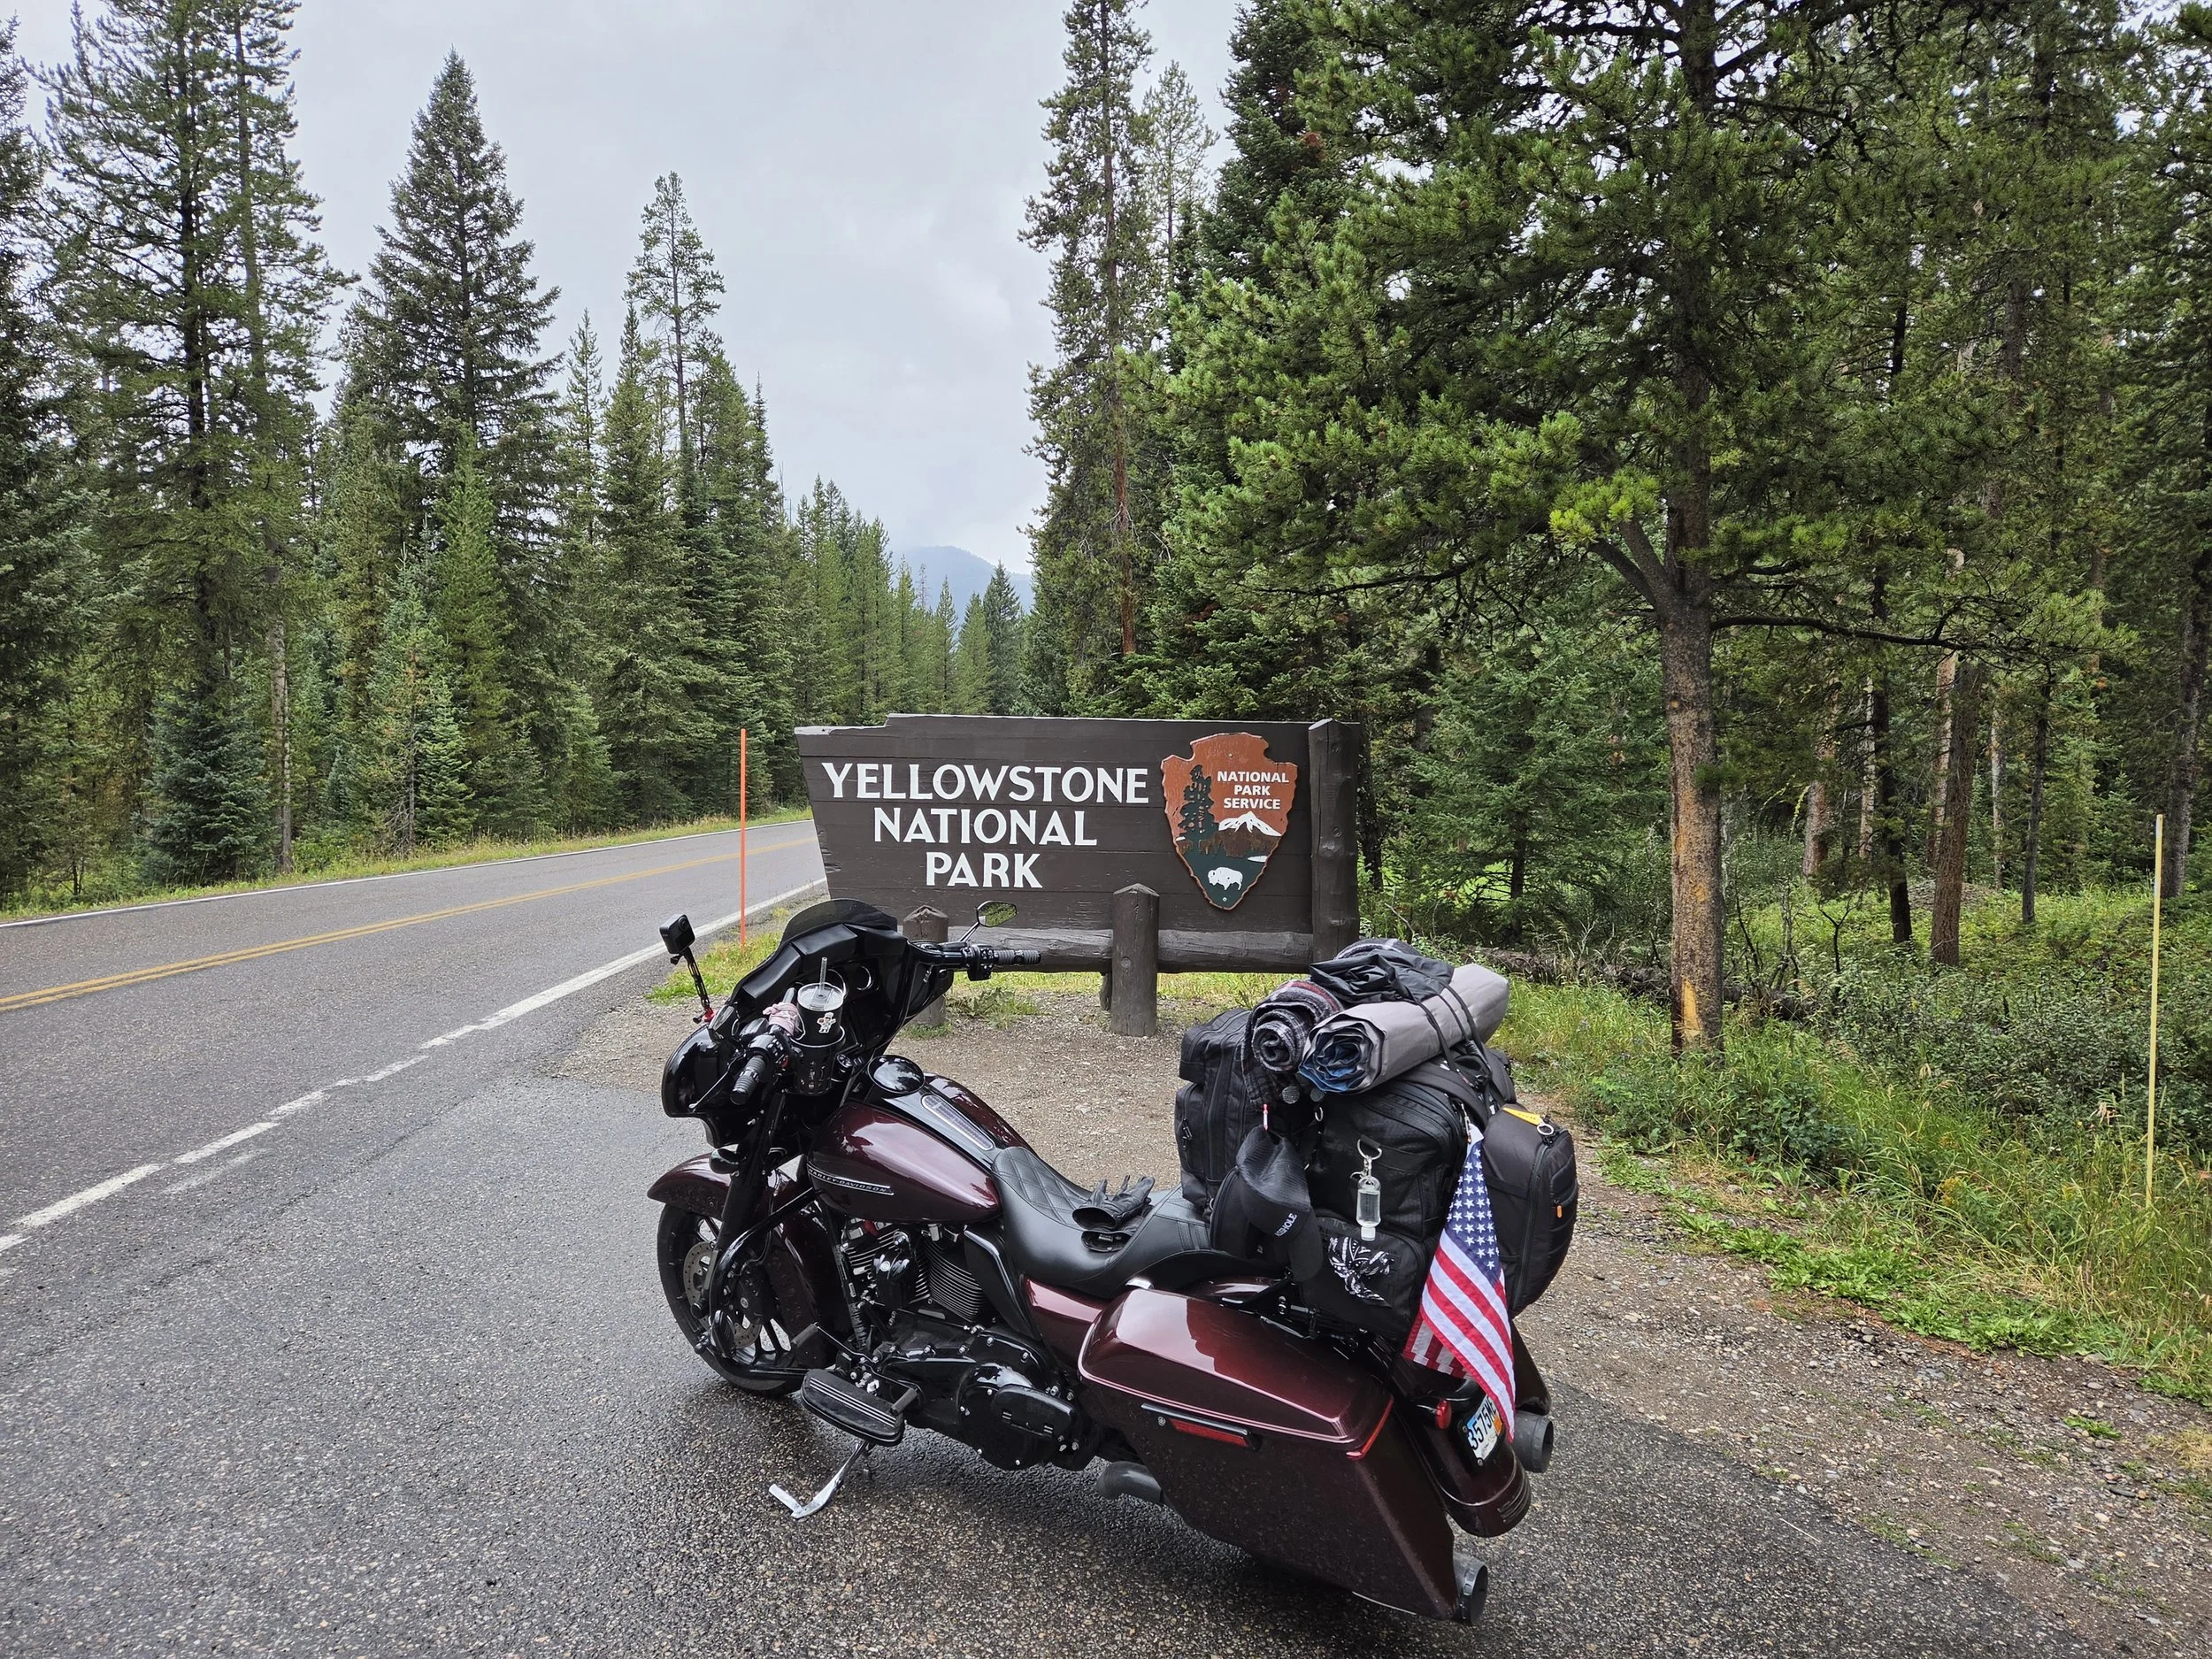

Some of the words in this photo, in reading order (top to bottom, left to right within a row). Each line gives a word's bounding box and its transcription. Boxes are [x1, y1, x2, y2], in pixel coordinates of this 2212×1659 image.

[821, 762, 1149, 803] YELLOWSTONE
[1217, 771, 1290, 783] NATIONAL
[1233, 784, 1271, 796] PARK
[1223, 797, 1281, 810] SERVICE
[873, 807, 1097, 846] NATIONAL
[926, 851, 1043, 888] PARK
[809, 1168, 887, 1193] HARLEY-DAVIDSON
